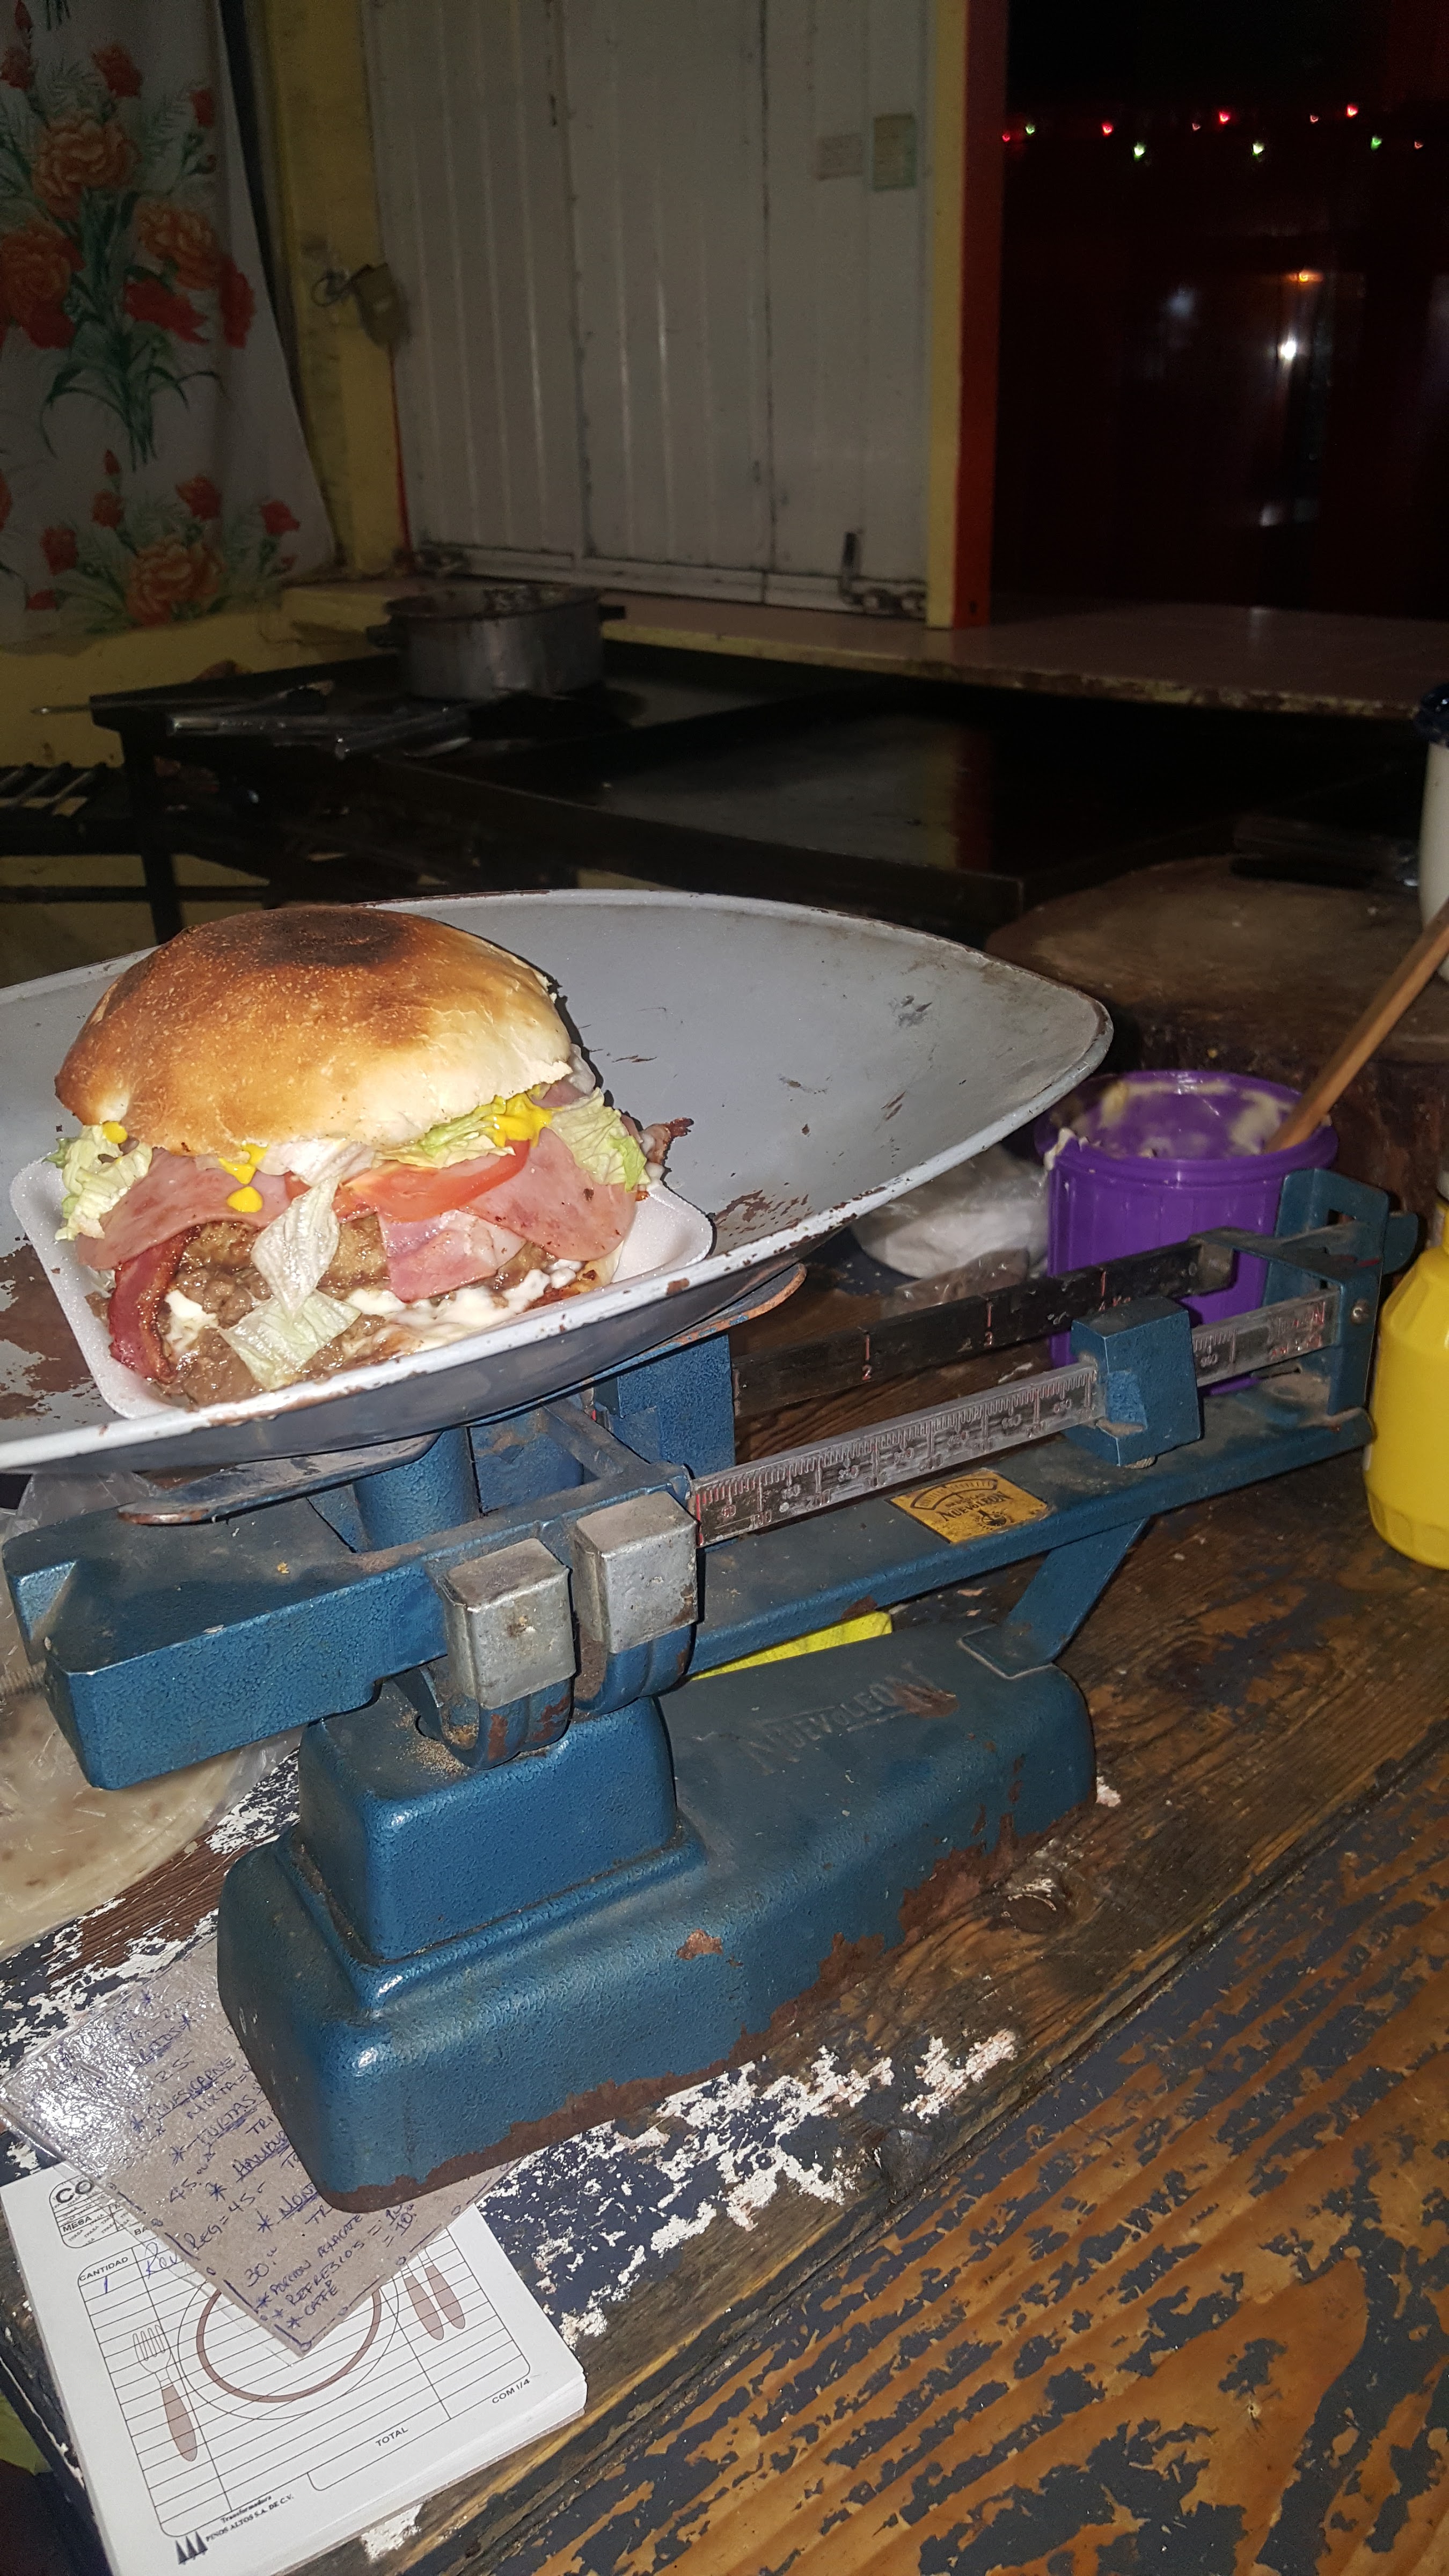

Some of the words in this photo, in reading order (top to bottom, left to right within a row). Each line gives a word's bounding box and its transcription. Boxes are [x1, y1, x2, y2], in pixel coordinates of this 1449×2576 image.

[861, 1364, 873, 1381] 2
[62, 2215, 92, 2233] MESA
[79, 2256, 129, 2282] CANTIDAD
[492, 2387, 515, 2404] COM
[375, 2426, 409, 2447] TOTAL
[230, 2513, 254, 2531] ALTOS
[268, 2501, 280, 2511] DE
